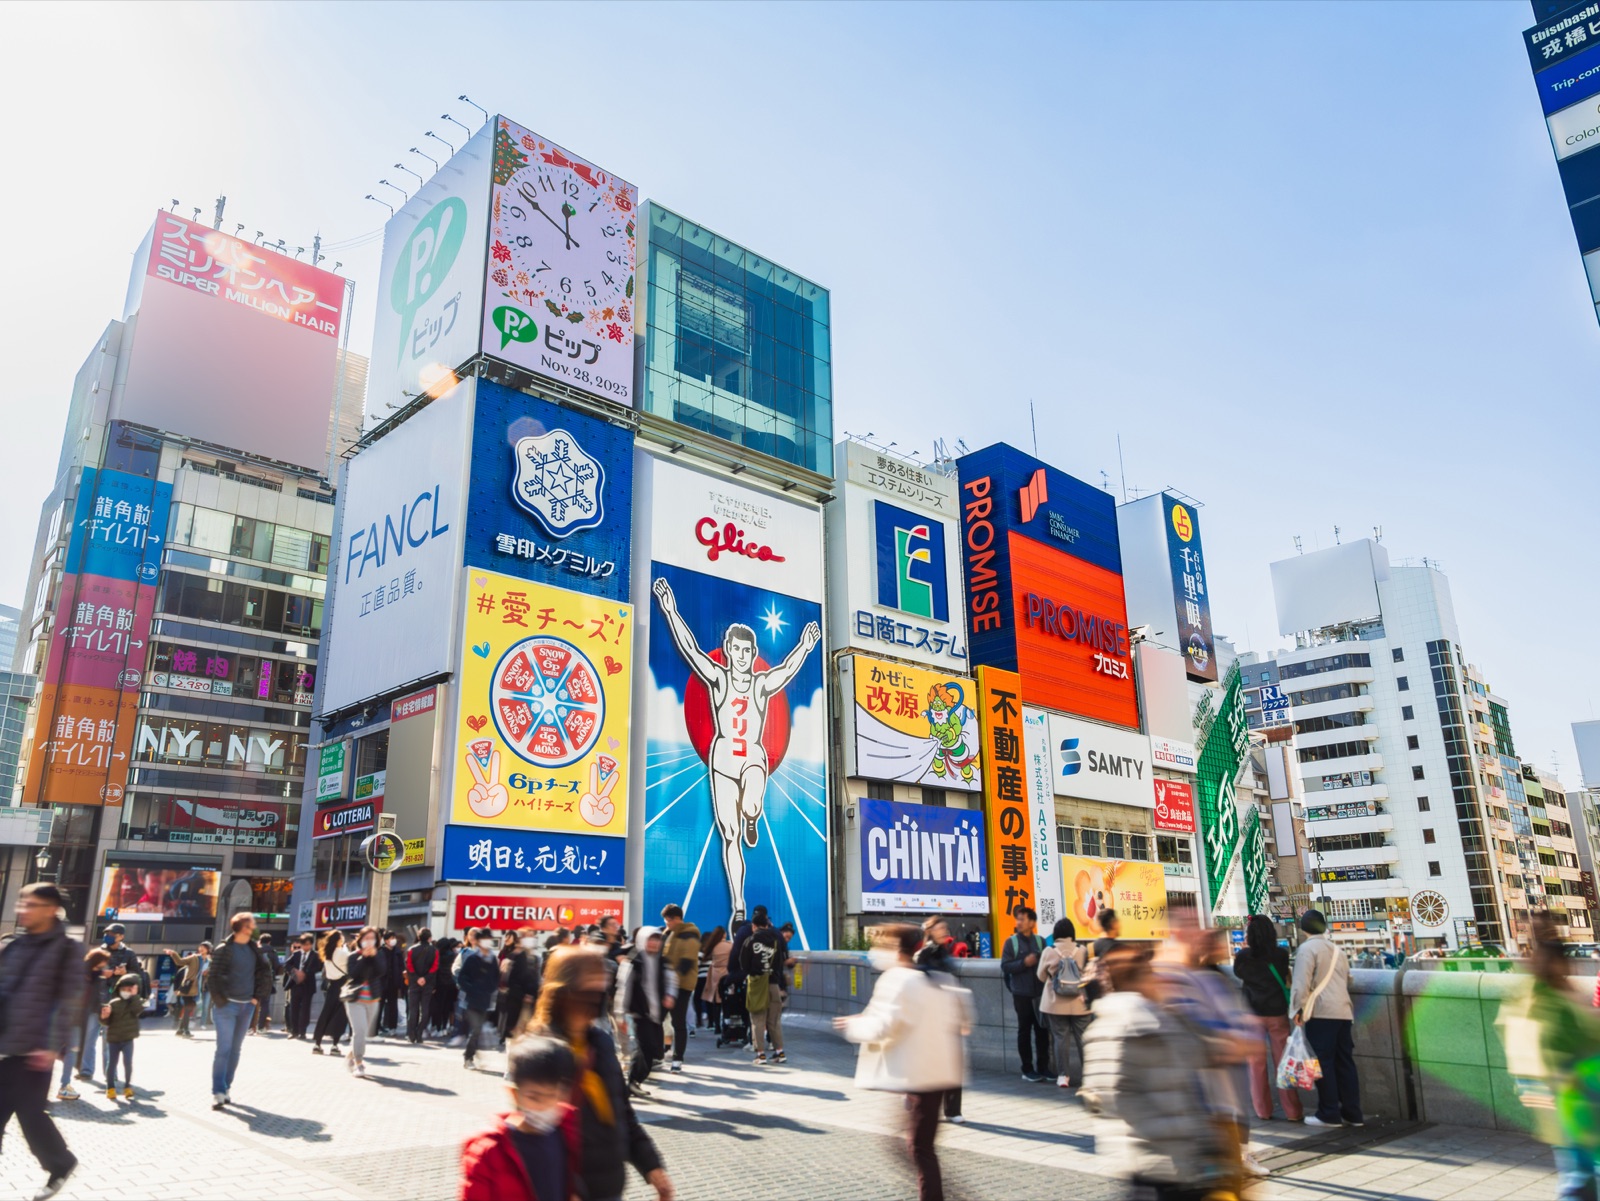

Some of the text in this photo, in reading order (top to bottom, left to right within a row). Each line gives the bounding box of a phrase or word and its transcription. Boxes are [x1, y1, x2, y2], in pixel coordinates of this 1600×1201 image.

[1531, 3, 1599, 44] Ebisubashi
[538, 175, 555, 192] 11
[561, 179, 579, 200] 12
[510, 206, 527, 221] 9
[588, 202, 598, 213] 1
[163, 217, 266, 265] スーパー
[516, 236, 533, 248] 8
[600, 226, 616, 238] 2
[536, 260, 552, 272] 7
[606, 250, 621, 265] 3
[159, 239, 338, 313] ミリオンヘアー
[560, 276, 572, 294] 6
[584, 279, 597, 297] 5
[601, 270, 615, 286] 4
[156, 264, 336, 335] SUPER MILLION HAIR
[411, 291, 462, 361] ピップ
[544, 324, 602, 365] ピップ
[540, 353, 628, 398] Nov. 28, 2023
[877, 456, 933, 486] 夢ある住まい
[868, 472, 943, 509] エステムシリーズ
[94, 495, 155, 527] 龍角散
[1048, 510, 1064, 523] SMBC
[1176, 506, 1190, 539] 占
[345, 484, 449, 585] FANCL
[695, 516, 786, 563] Glico
[1049, 518, 1080, 538] CONSUMER
[1050, 526, 1075, 544] FINANCE
[494, 532, 616, 578] 雪印メグミルク
[964, 476, 1001, 633] PROMISE
[358, 567, 424, 619] 正直品質。
[1180, 546, 1203, 630] 千里眼
[76, 602, 138, 631] 龍角散
[1027, 592, 1127, 656] PROMISE
[857, 610, 967, 659] 日商エステム
[173, 649, 229, 678] 焼肉
[539, 647, 566, 660] SNOW
[1094, 653, 1129, 680] プロミス
[504, 656, 524, 684] SNOW
[578, 670, 595, 698] SNOW
[871, 667, 914, 690] かぜに
[865, 684, 919, 719] 改源
[56, 714, 119, 743] 龍角散
[501, 705, 520, 735] SNOW
[575, 718, 593, 745] SNOW
[731, 695, 749, 758] グリコ
[1025, 715, 1039, 727] Asue
[533, 744, 561, 755] SNOW
[1087, 749, 1144, 780] SAMTY
[332, 805, 372, 827] LOTTERIA
[990, 687, 1031, 933] 不動産の事な
[1034, 753, 1049, 872] 株式会社 Asue
[866, 898, 886, 907] 天気予報
[1120, 891, 1143, 902] 大阪土産
[464, 905, 555, 920] LOTTERIA
